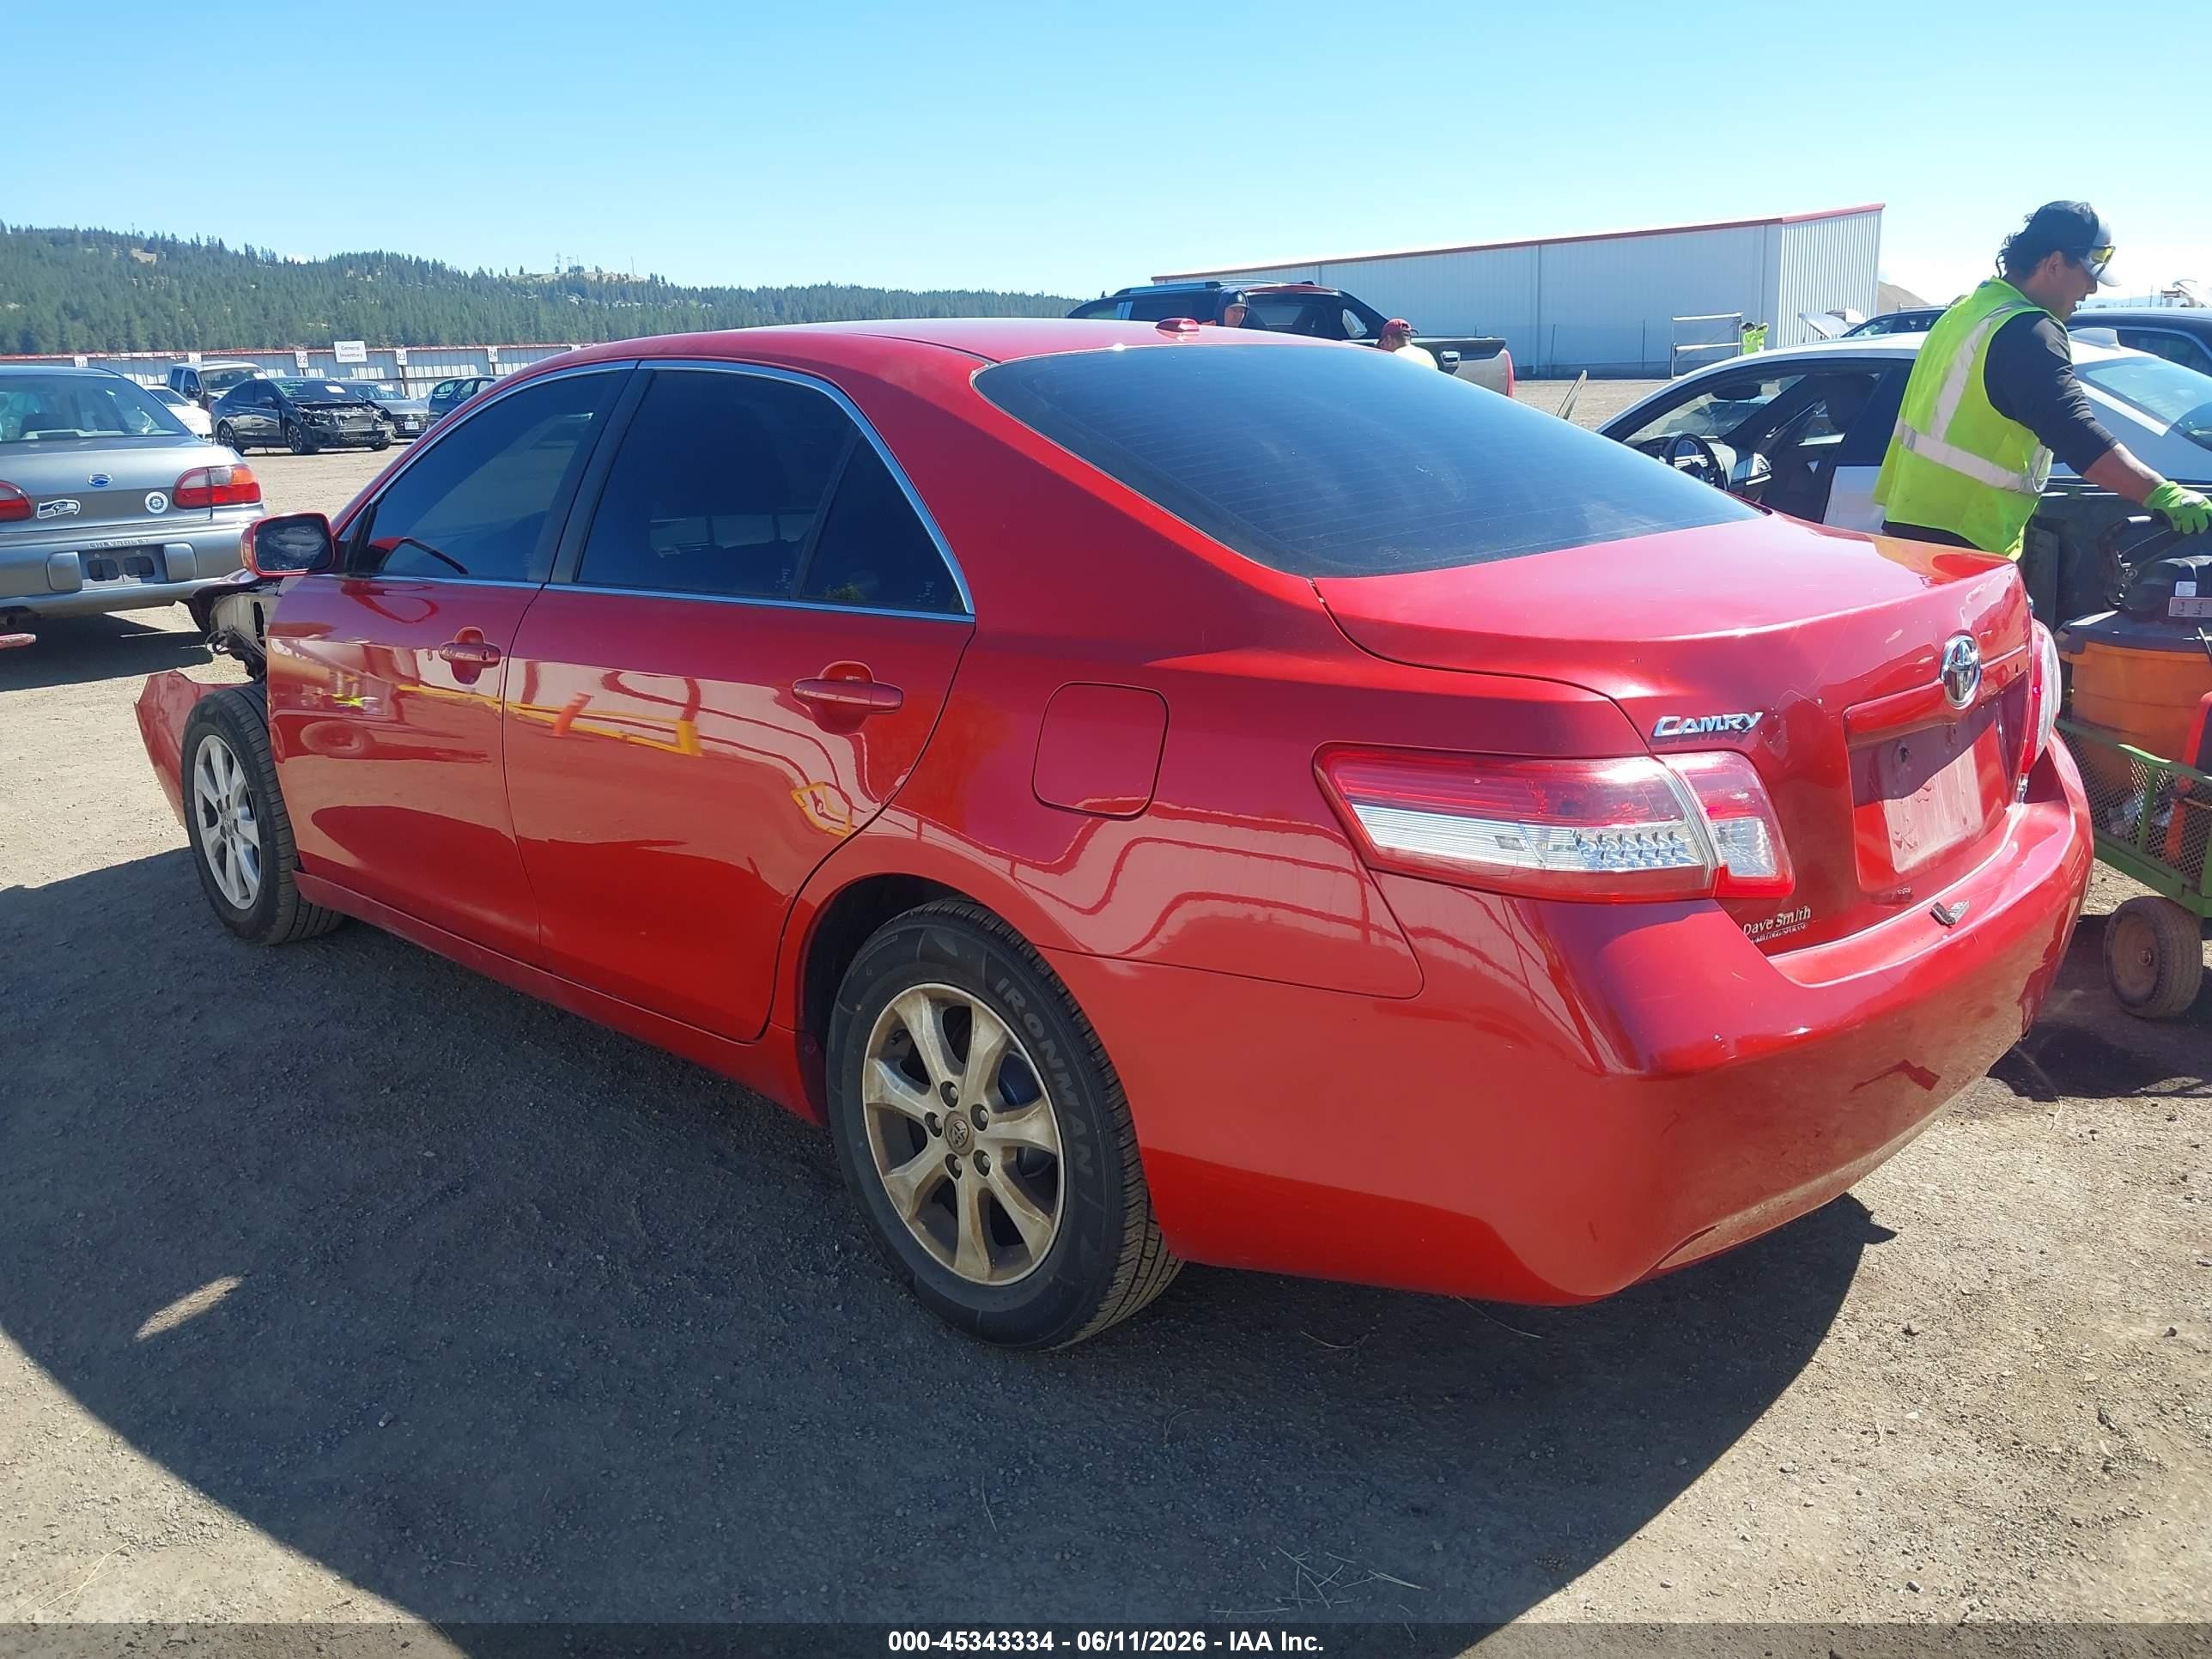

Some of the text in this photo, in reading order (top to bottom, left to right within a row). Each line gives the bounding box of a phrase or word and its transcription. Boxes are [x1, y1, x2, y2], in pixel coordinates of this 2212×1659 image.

[297, 356, 307, 364] 22
[88, 538, 149, 549] CHEVROLET
[1654, 711, 1764, 737] CAMRY
[1743, 919, 1774, 936] Dave
[1775, 906, 1811, 927] Smith
[995, 977, 1094, 1176] IRONMAN
